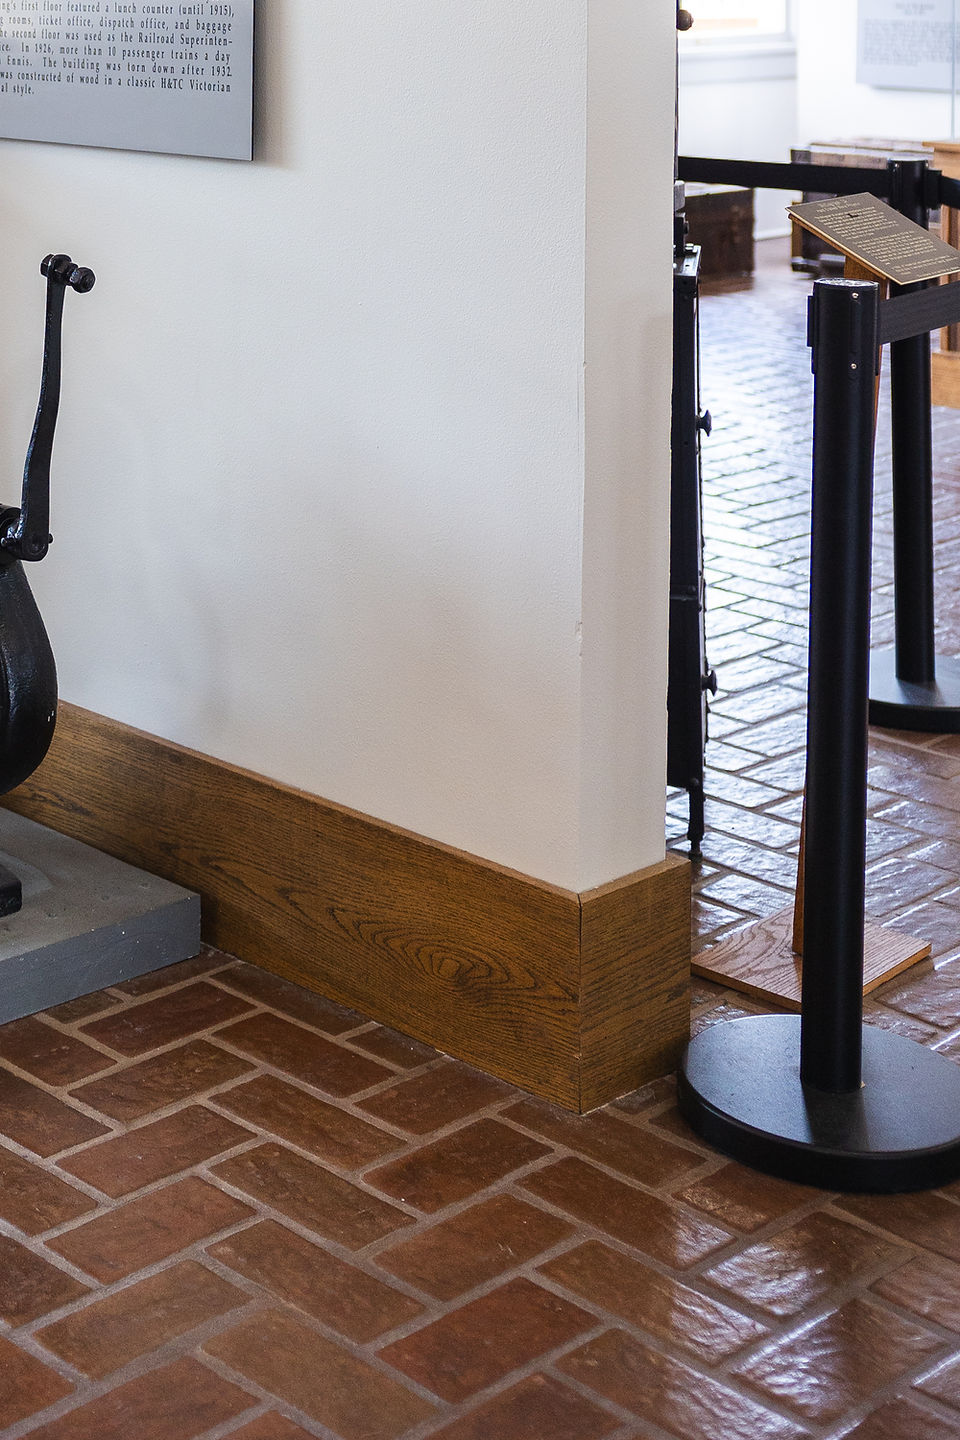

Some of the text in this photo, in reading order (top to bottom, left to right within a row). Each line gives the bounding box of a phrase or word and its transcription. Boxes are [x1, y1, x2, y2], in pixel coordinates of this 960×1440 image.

[21, 0, 38, 10] first
[43, 1, 62, 12] floor
[68, 1, 100, 12] featured
[114, 2, 136, 13] lunch
[142, 4, 173, 14] counter
[179, 4, 203, 16] (until
[210, 5, 234, 18] 1915),
[9, 16, 33, 26] rooms,
[39, 15, 62, 25] ticket
[67, 16, 94, 28] office,
[100, 16, 134, 30] dispatch
[141, 18, 168, 31] office,
[175, 19, 189, 29] and
[196, 19, 232, 34] baggage
[12, 28, 36, 38] second
[41, 29, 60, 39] floor
[84, 30, 101, 41] used
[120, 32, 132, 42] the
[139, 32, 174, 44] Railroad
[180, 33, 232, 48] Superinten-
[22, 42, 29, 52] In
[35, 43, 54, 55] 1926,
[60, 46, 78, 54] more
[84, 45, 102, 56] than
[108, 46, 116, 56] 10
[122, 48, 164, 61] passenger
[171, 49, 198, 60] trains
[205, 52, 208, 60] a
[215, 50, 230, 65] day
[7, 55, 32, 66] Ennis.
[43, 56, 56, 67] The
[63, 58, 99, 73] building
[106, 62, 121, 71] was
[128, 62, 145, 72] torn
[152, 62, 174, 74] down
[182, 64, 204, 75] after
[0, 71, 13, 79] was
[18, 71, 61, 82] constructed
[66, 72, 74, 83] of
[80, 74, 99, 84] wood
[104, 74, 112, 86] in
[127, 76, 155, 88] classic
[161, 78, 183, 89] H&TC
[190, 79, 230, 92] Victorian
[13, 83, 34, 96] style.
